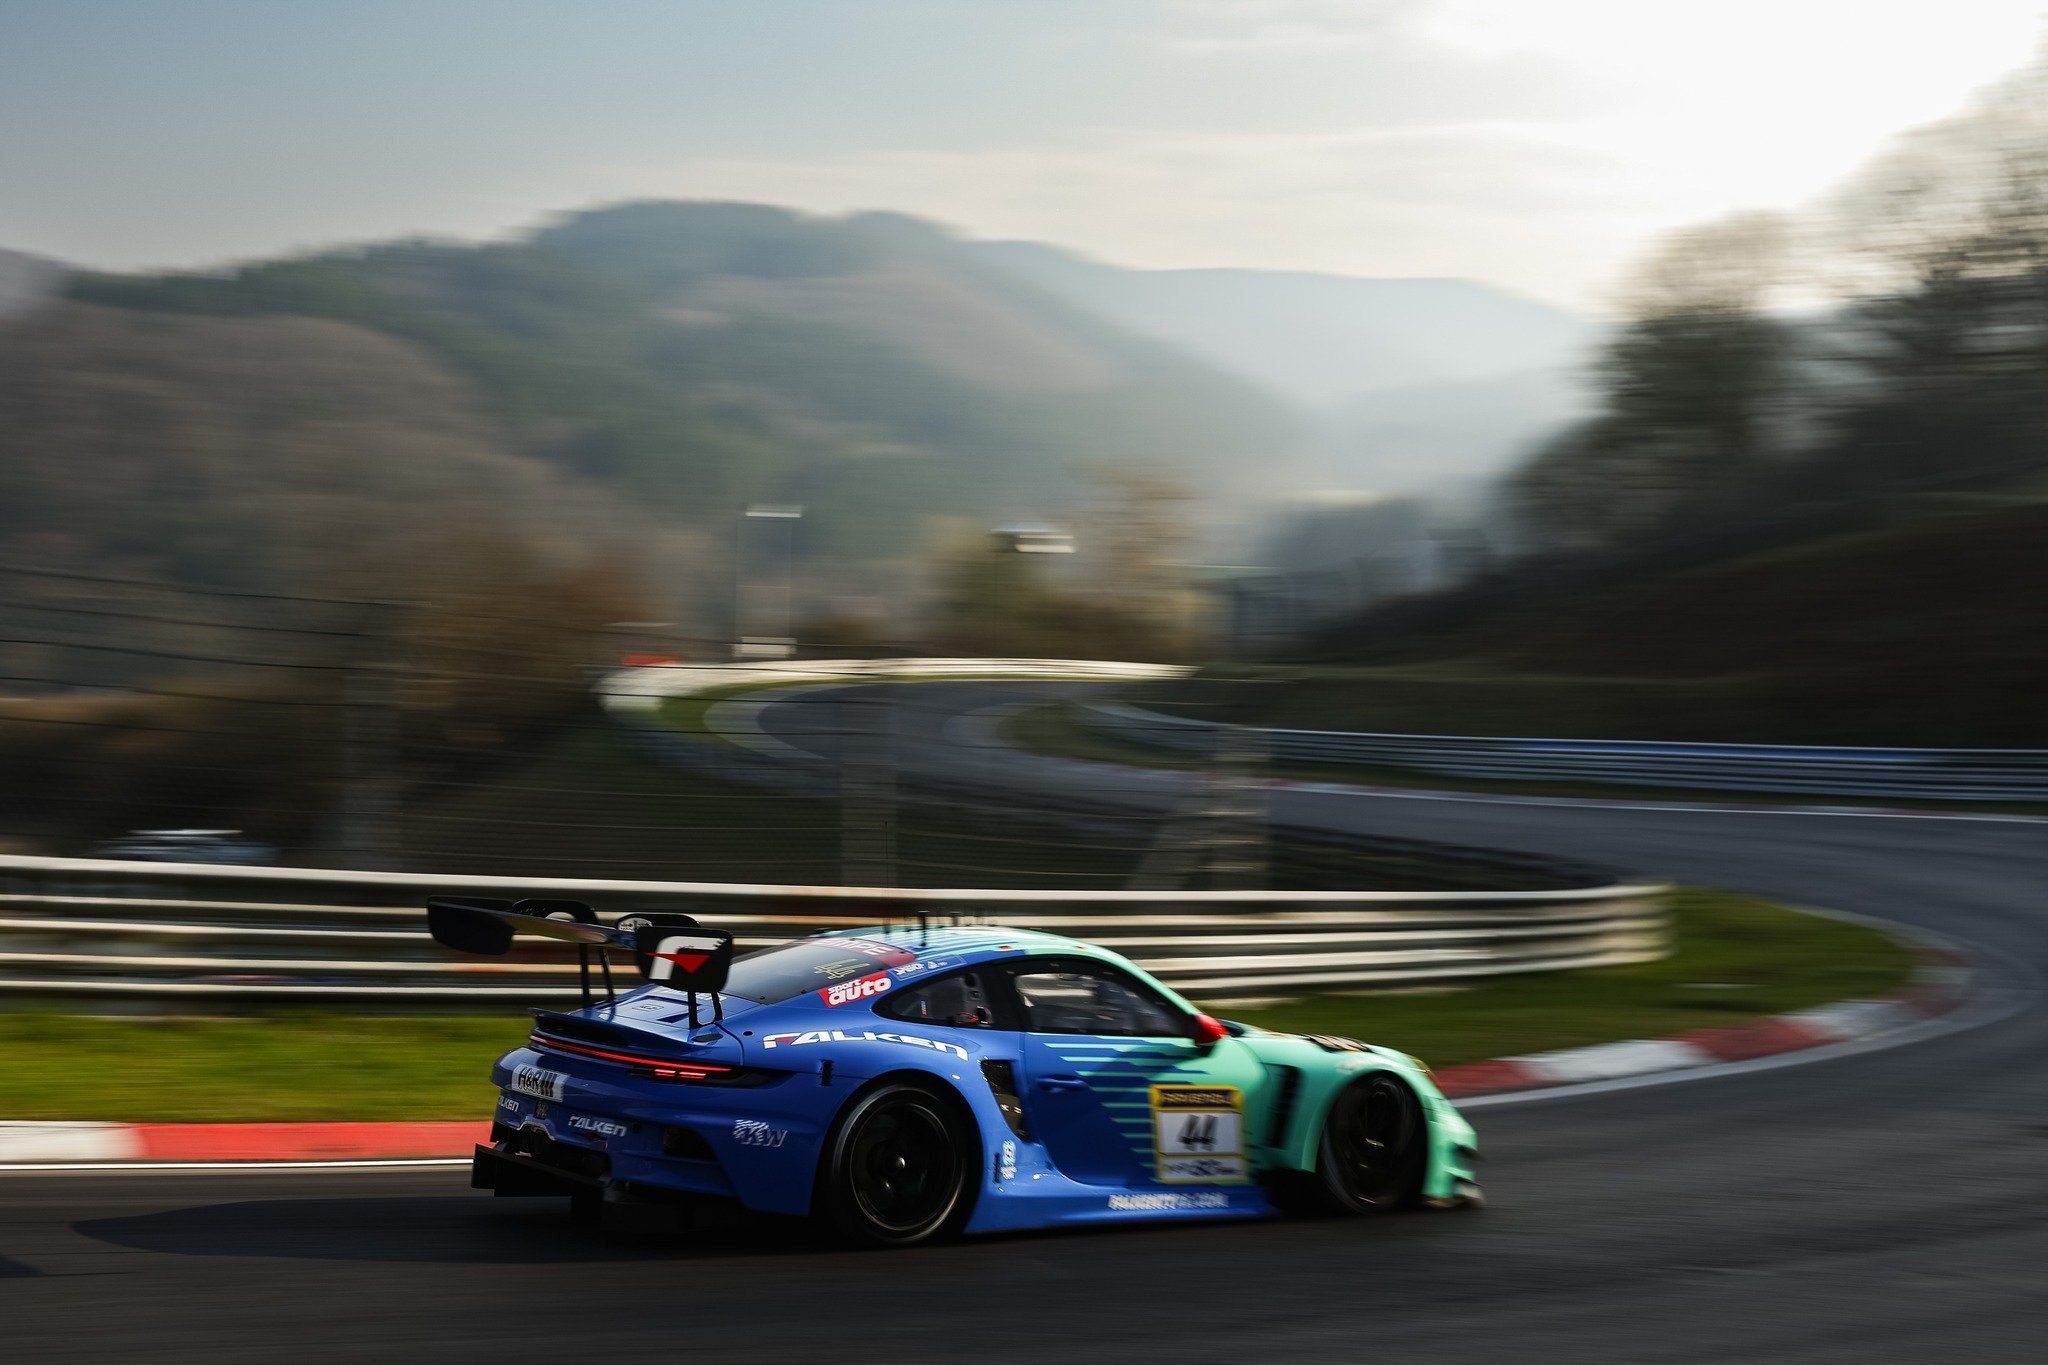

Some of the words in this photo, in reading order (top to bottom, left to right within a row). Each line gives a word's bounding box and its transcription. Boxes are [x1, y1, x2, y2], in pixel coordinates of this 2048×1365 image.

[828, 979, 862, 994] sport
[829, 977, 892, 1006] auto
[762, 1029, 970, 1062] FALKEN
[567, 1115, 628, 1137] FALKEN
[1177, 1114, 1219, 1152] 44
